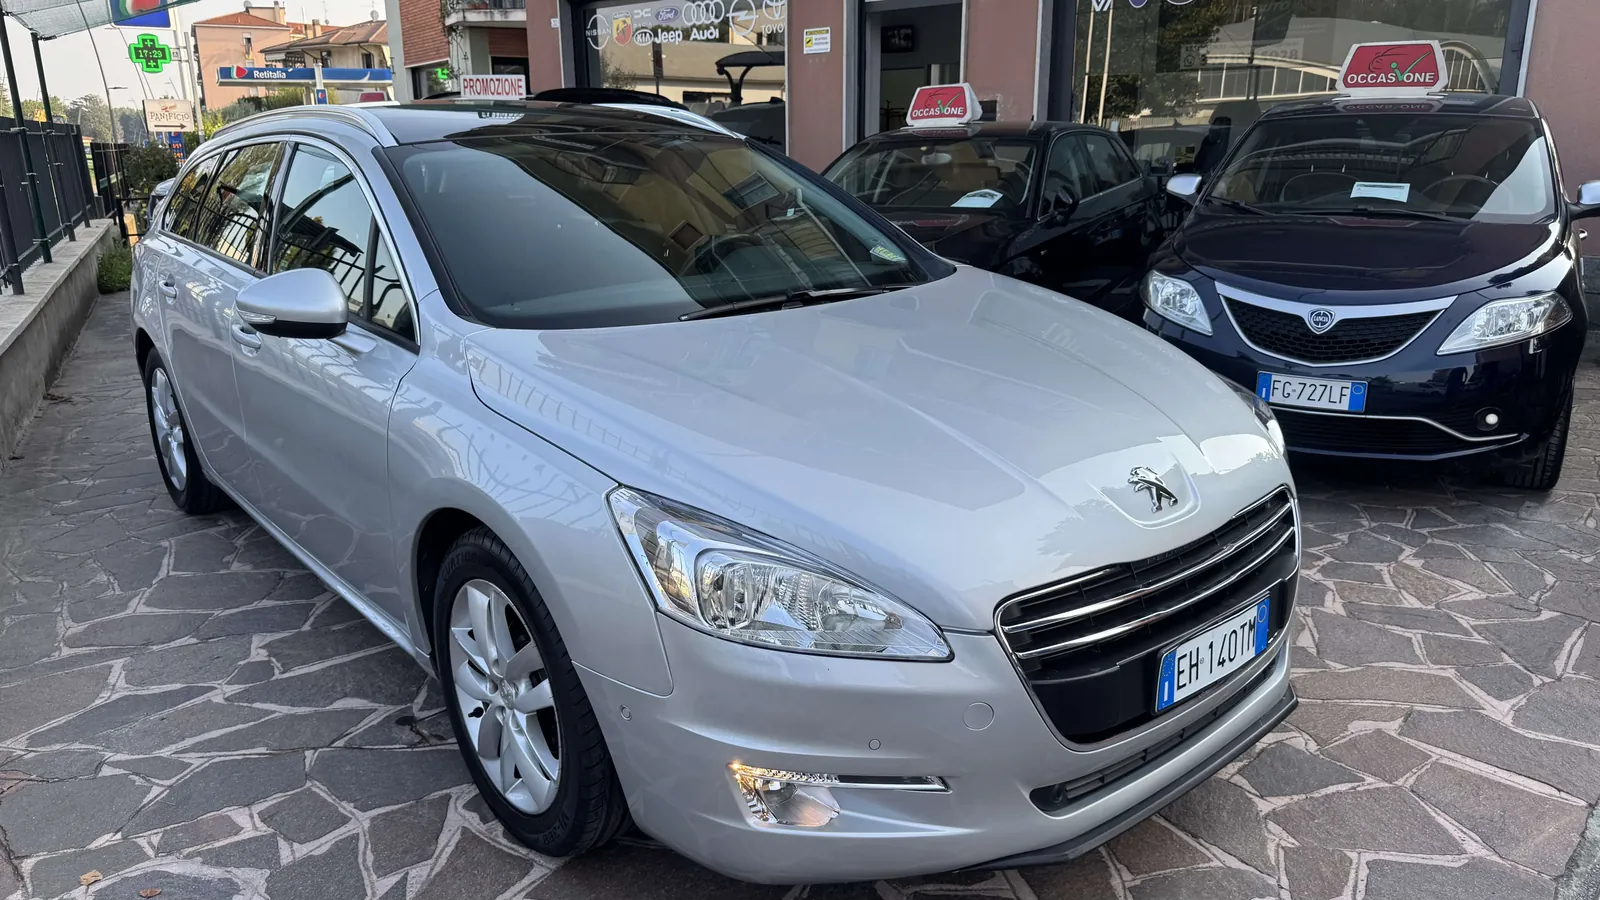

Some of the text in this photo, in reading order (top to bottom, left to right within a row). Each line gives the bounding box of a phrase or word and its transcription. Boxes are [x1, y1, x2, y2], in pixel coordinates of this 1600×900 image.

[658, 8, 675, 20] Ford
[586, 28, 611, 36] NISSAN
[689, 26, 719, 41] Audi
[761, 24, 785, 35] TOYO
[636, 32, 651, 43] KIA
[655, 28, 683, 45] Jeep
[138, 50, 163, 58] 17:29
[253, 70, 286, 79] Retitalia
[463, 78, 523, 96] PROMOZIONE
[150, 112, 190, 121] PANIFICIO
[1208, 615, 1257, 674] 140TM
